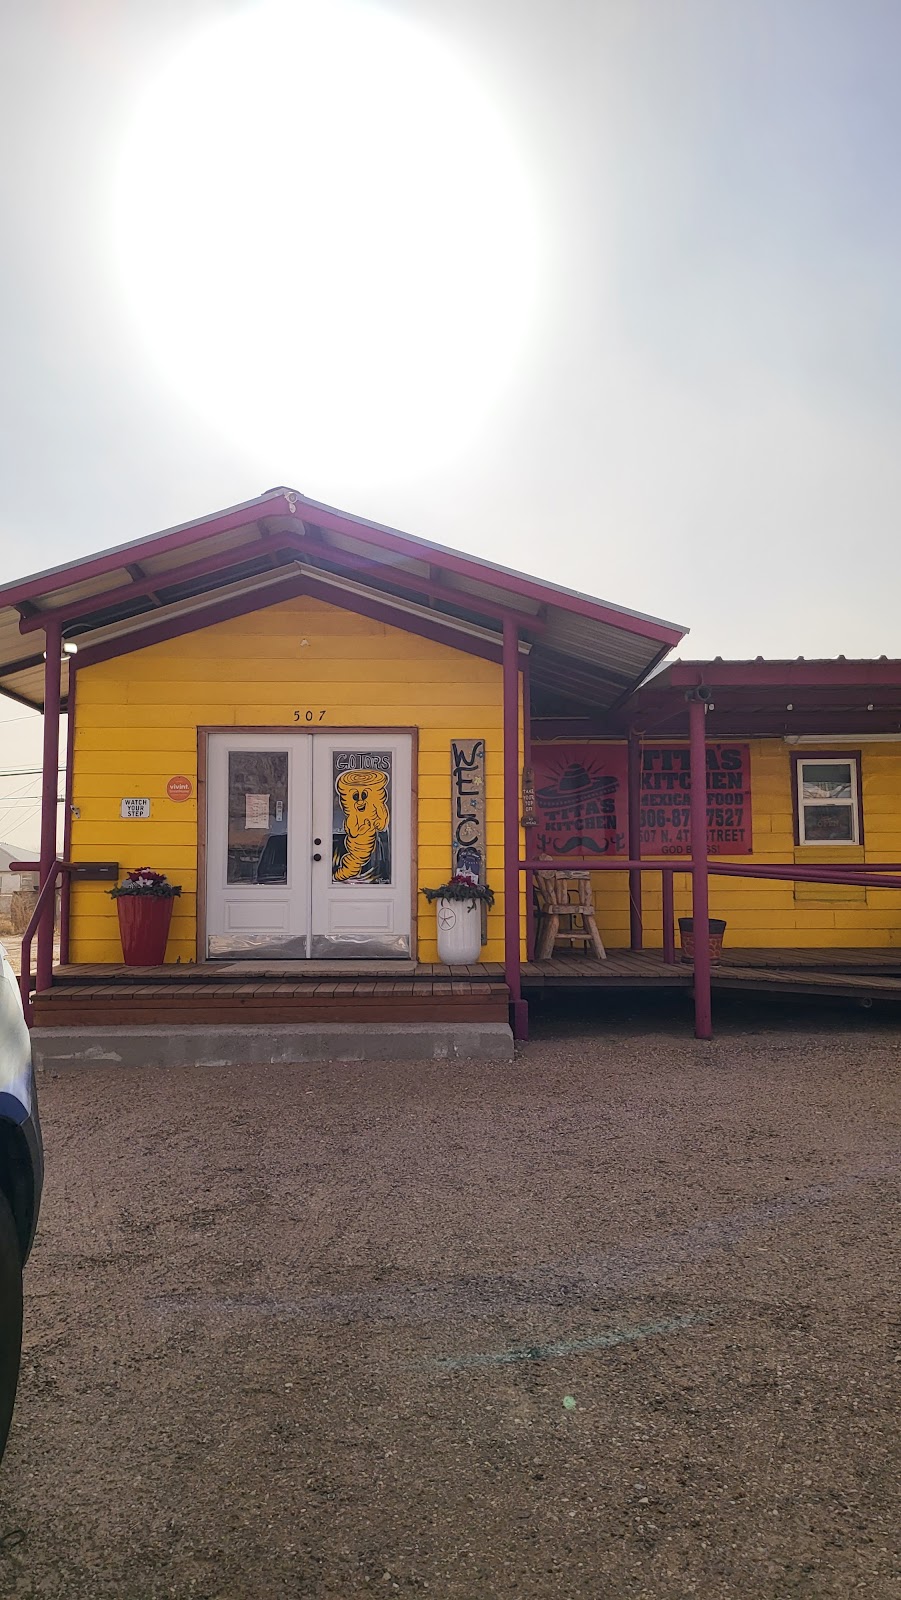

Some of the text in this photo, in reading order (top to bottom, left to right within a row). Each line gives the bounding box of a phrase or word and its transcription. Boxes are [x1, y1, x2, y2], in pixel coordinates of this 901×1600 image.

[294, 710, 326, 721] 507
[641, 793, 744, 806] MEXICA FOOD
[545, 815, 617, 831] KITCHEN
[661, 829, 672, 843] N.
[676, 829, 690, 842] 4T
[661, 846, 720, 854] GOD BSS!
